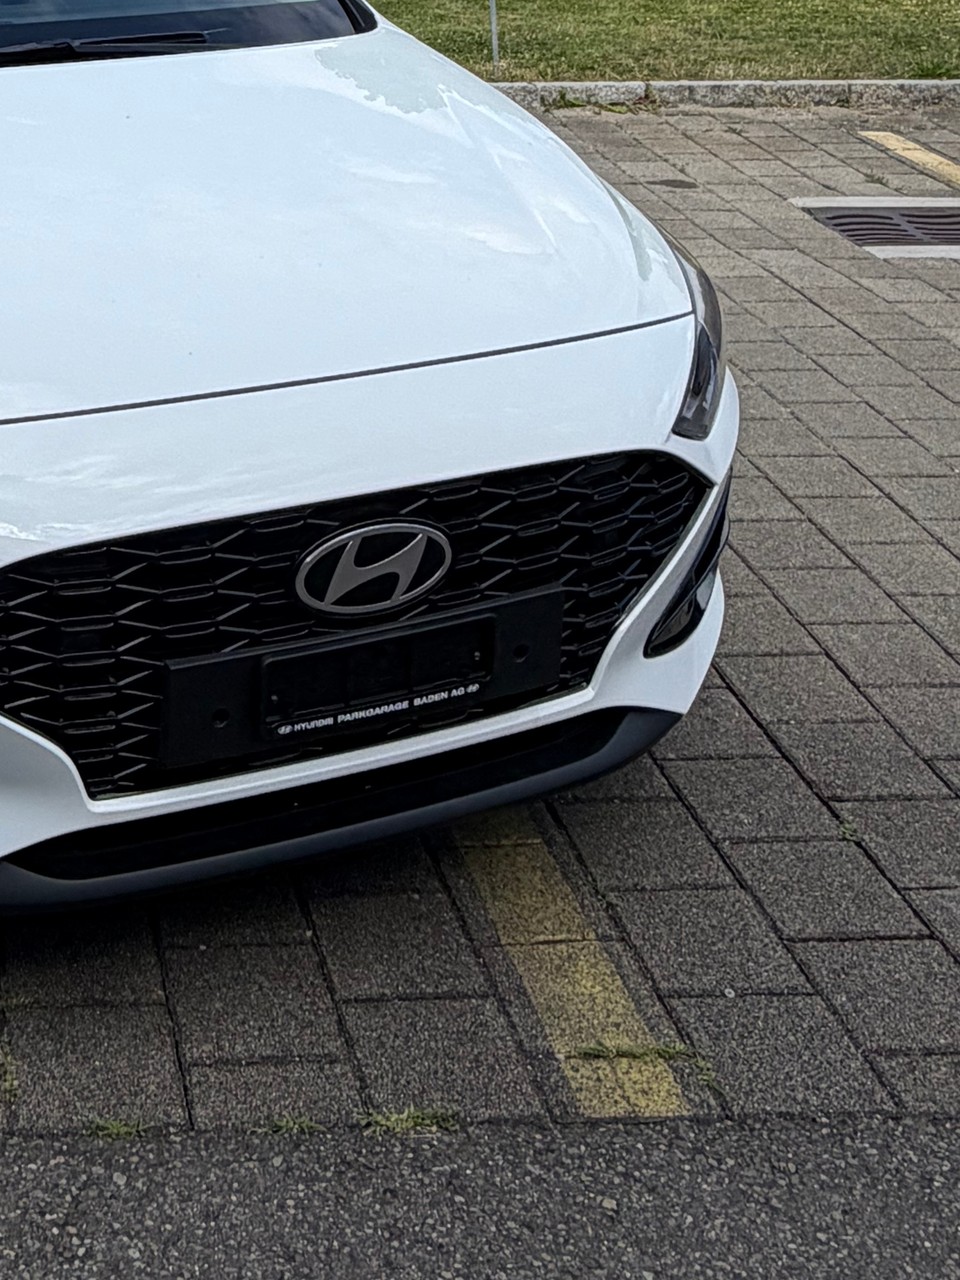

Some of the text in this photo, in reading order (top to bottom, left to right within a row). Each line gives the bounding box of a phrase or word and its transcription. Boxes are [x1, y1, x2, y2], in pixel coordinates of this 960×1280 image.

[294, 686, 465, 732] HYUNDAI PARKGARAGE BADEN AG
